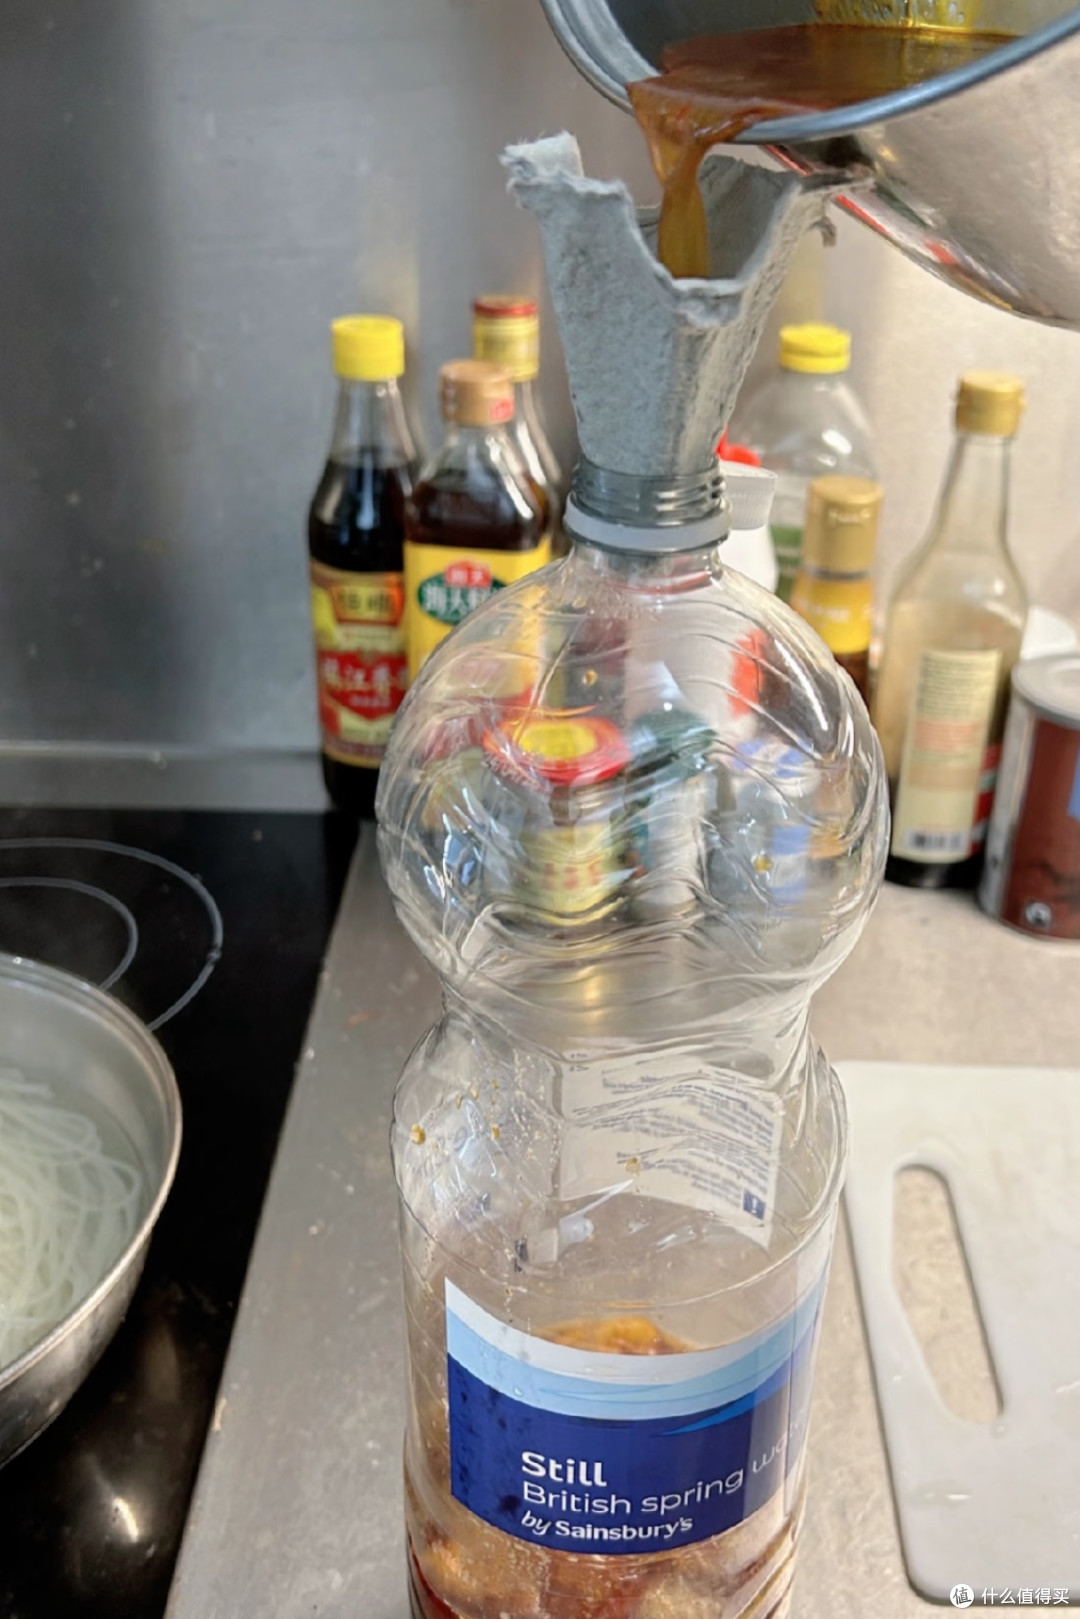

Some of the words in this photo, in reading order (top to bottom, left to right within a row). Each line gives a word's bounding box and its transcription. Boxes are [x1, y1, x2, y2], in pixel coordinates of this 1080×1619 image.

[521, 1450, 607, 1487] Still
[523, 1480, 631, 1515] British
[640, 1467, 744, 1516] spring
[520, 1509, 551, 1536] by
[555, 1516, 693, 1541] Sainsbury's
